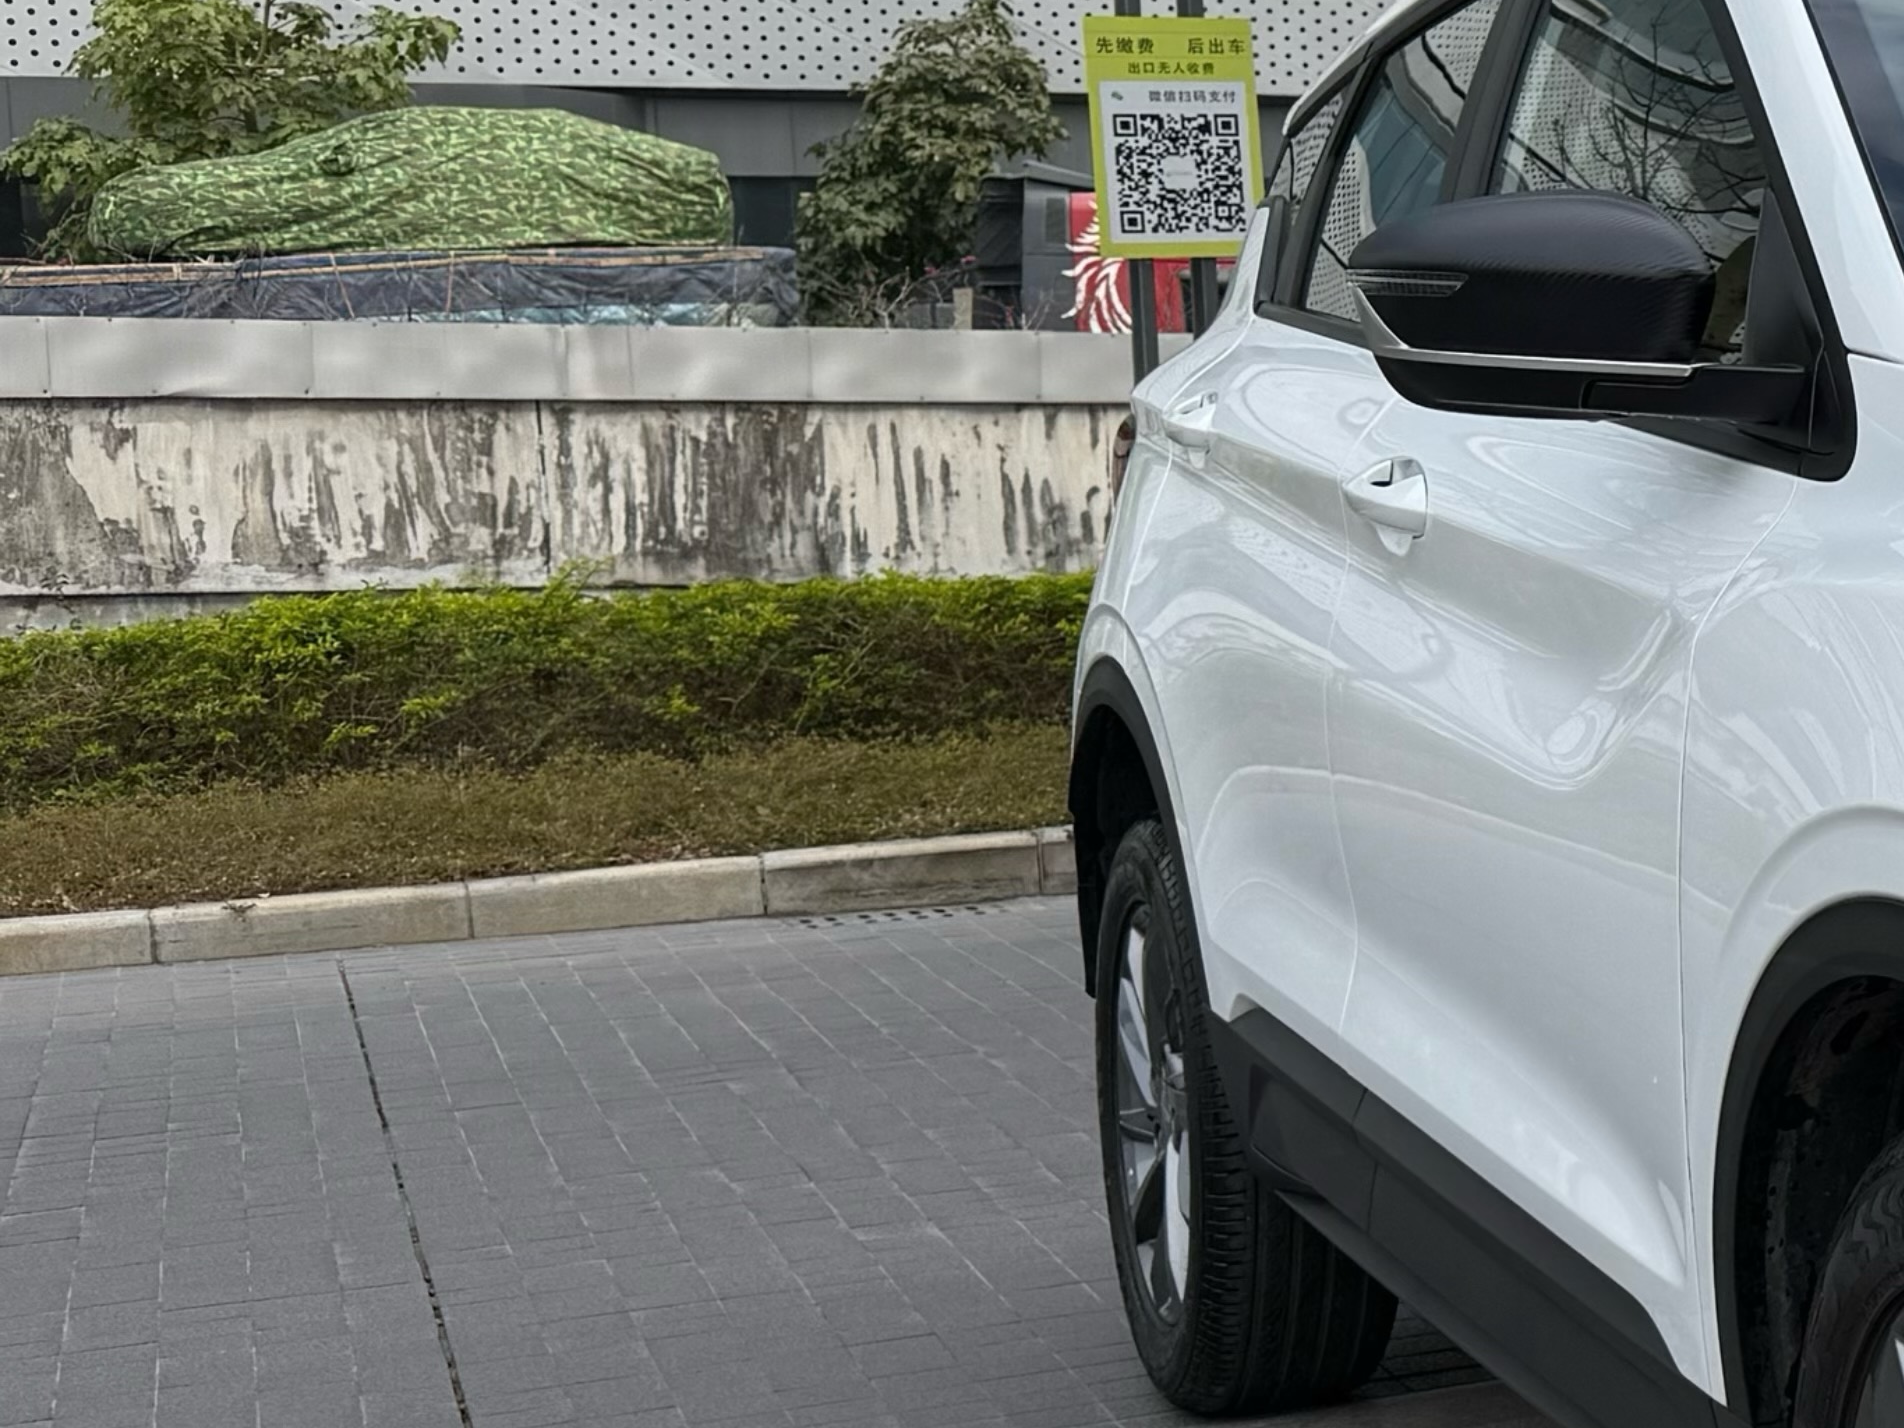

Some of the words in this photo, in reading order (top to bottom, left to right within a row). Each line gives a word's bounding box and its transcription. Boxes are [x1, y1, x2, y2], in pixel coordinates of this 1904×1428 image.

[1096, 37, 1154, 54] 先缴费
[1188, 38, 1245, 54] 后出车
[1128, 62, 1215, 75] 出口无人收费
[1149, 90, 1236, 103] 微信扫码支付
